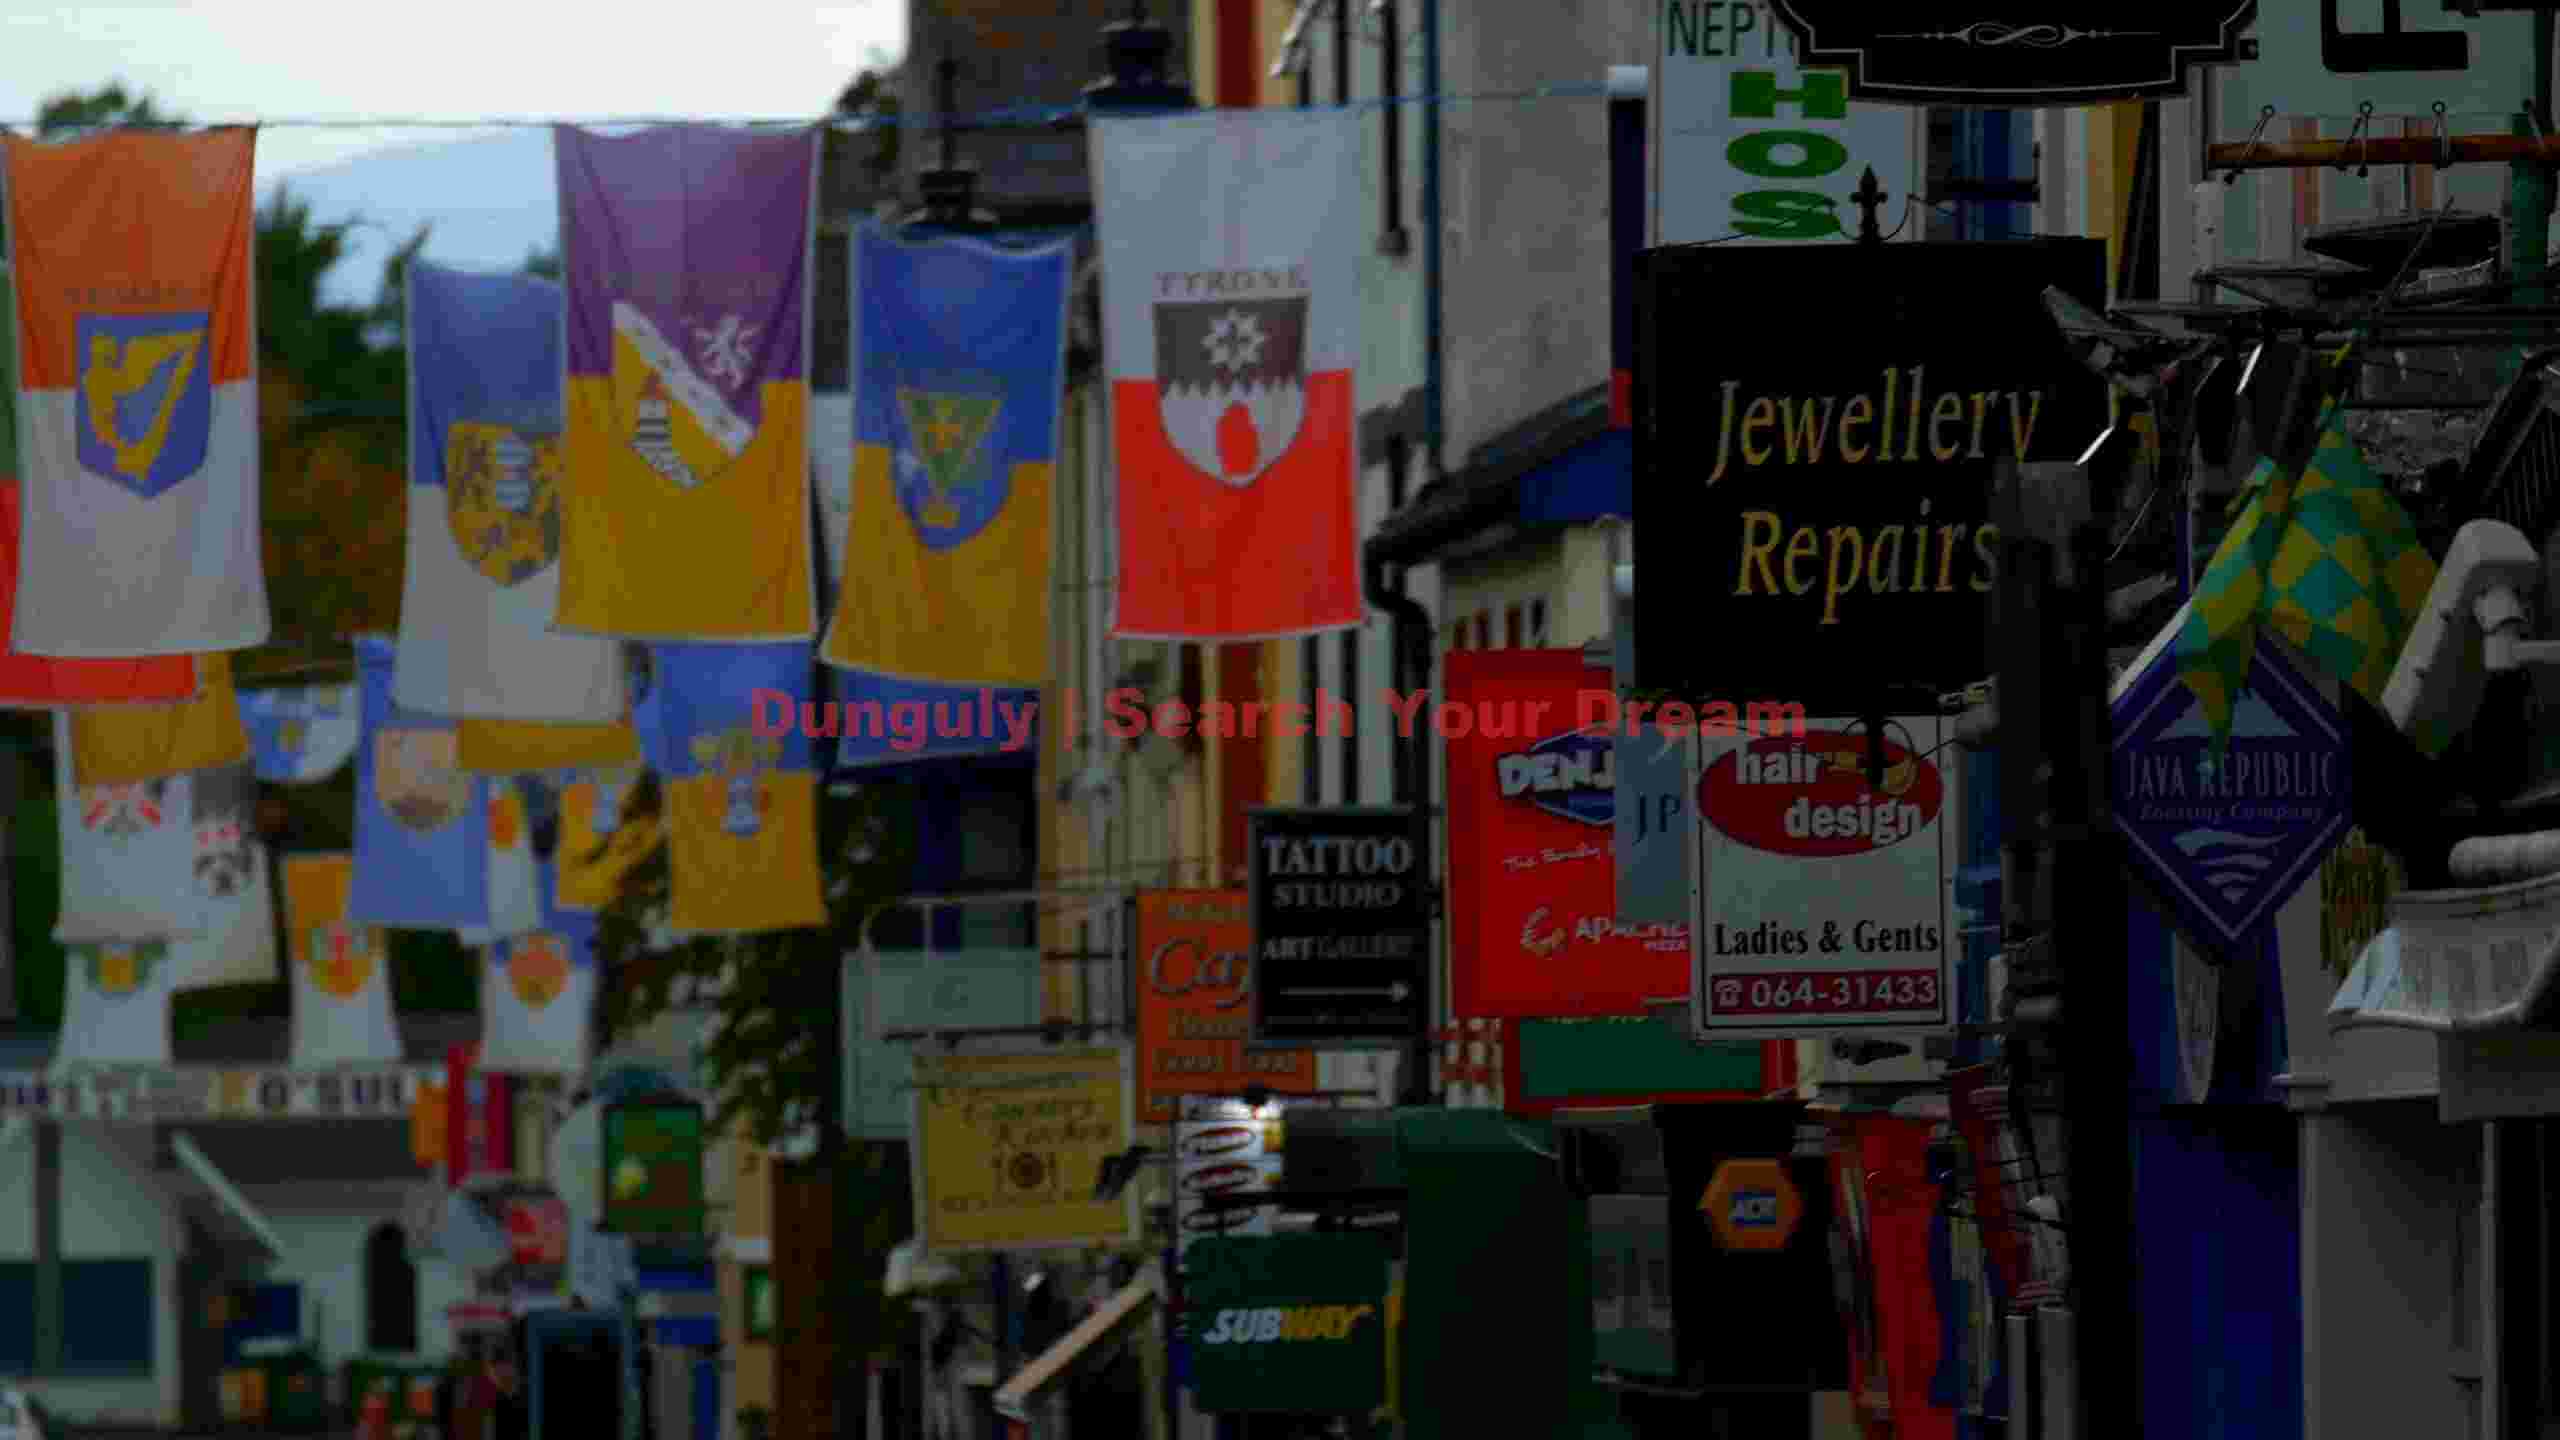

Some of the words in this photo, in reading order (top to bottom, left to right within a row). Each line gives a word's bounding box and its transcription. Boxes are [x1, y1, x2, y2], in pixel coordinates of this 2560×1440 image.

[1668, 0, 1797, 58] NEPT
[1703, 361, 2050, 488] Jewellery
[1728, 497, 2000, 625] Repairs
[1736, 741, 1824, 785] hair
[2123, 750, 2187, 800] JAVA
[2197, 750, 2337, 800] REPUBLIC
[1784, 793, 1922, 844] design
[1262, 835, 1415, 878] TATTOO
[1272, 880, 1406, 912] STUDIO
[1262, 935, 1317, 959] ART
[1714, 921, 1809, 956] Ladies
[1818, 919, 1846, 953] &
[1853, 919, 1939, 953] Gents
[1750, 975, 1938, 1010] 064-31433
[1201, 1303, 1374, 1344] SUBWAY
